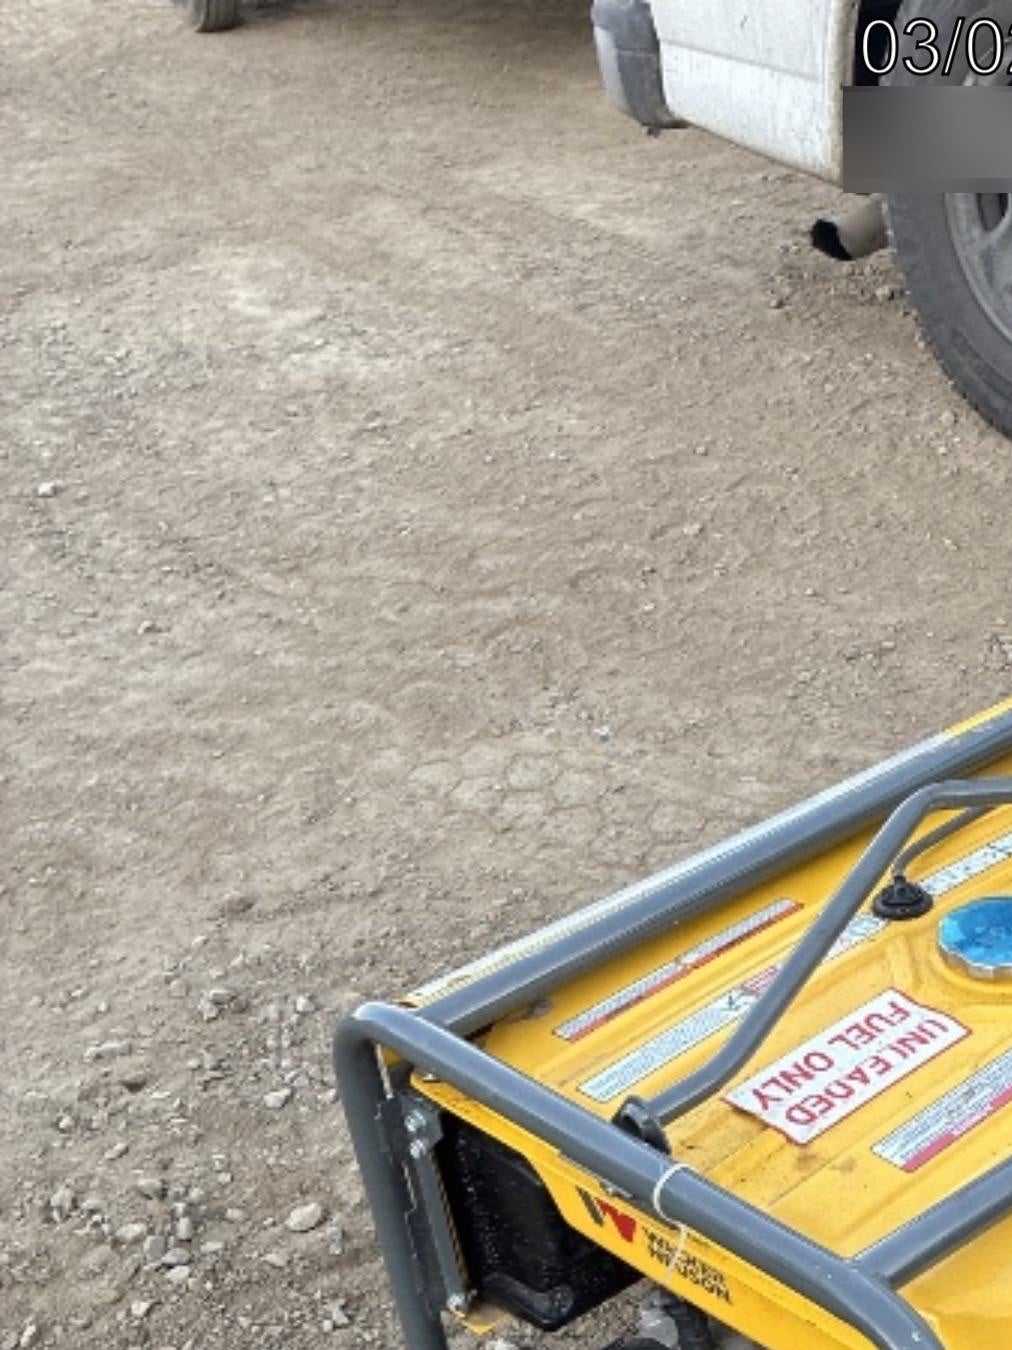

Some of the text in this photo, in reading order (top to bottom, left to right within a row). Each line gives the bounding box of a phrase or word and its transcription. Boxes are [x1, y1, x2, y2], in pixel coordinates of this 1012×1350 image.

[752, 1000, 911, 1111] FUEL ONLY
[785, 1018, 949, 1126] UNLEADED
